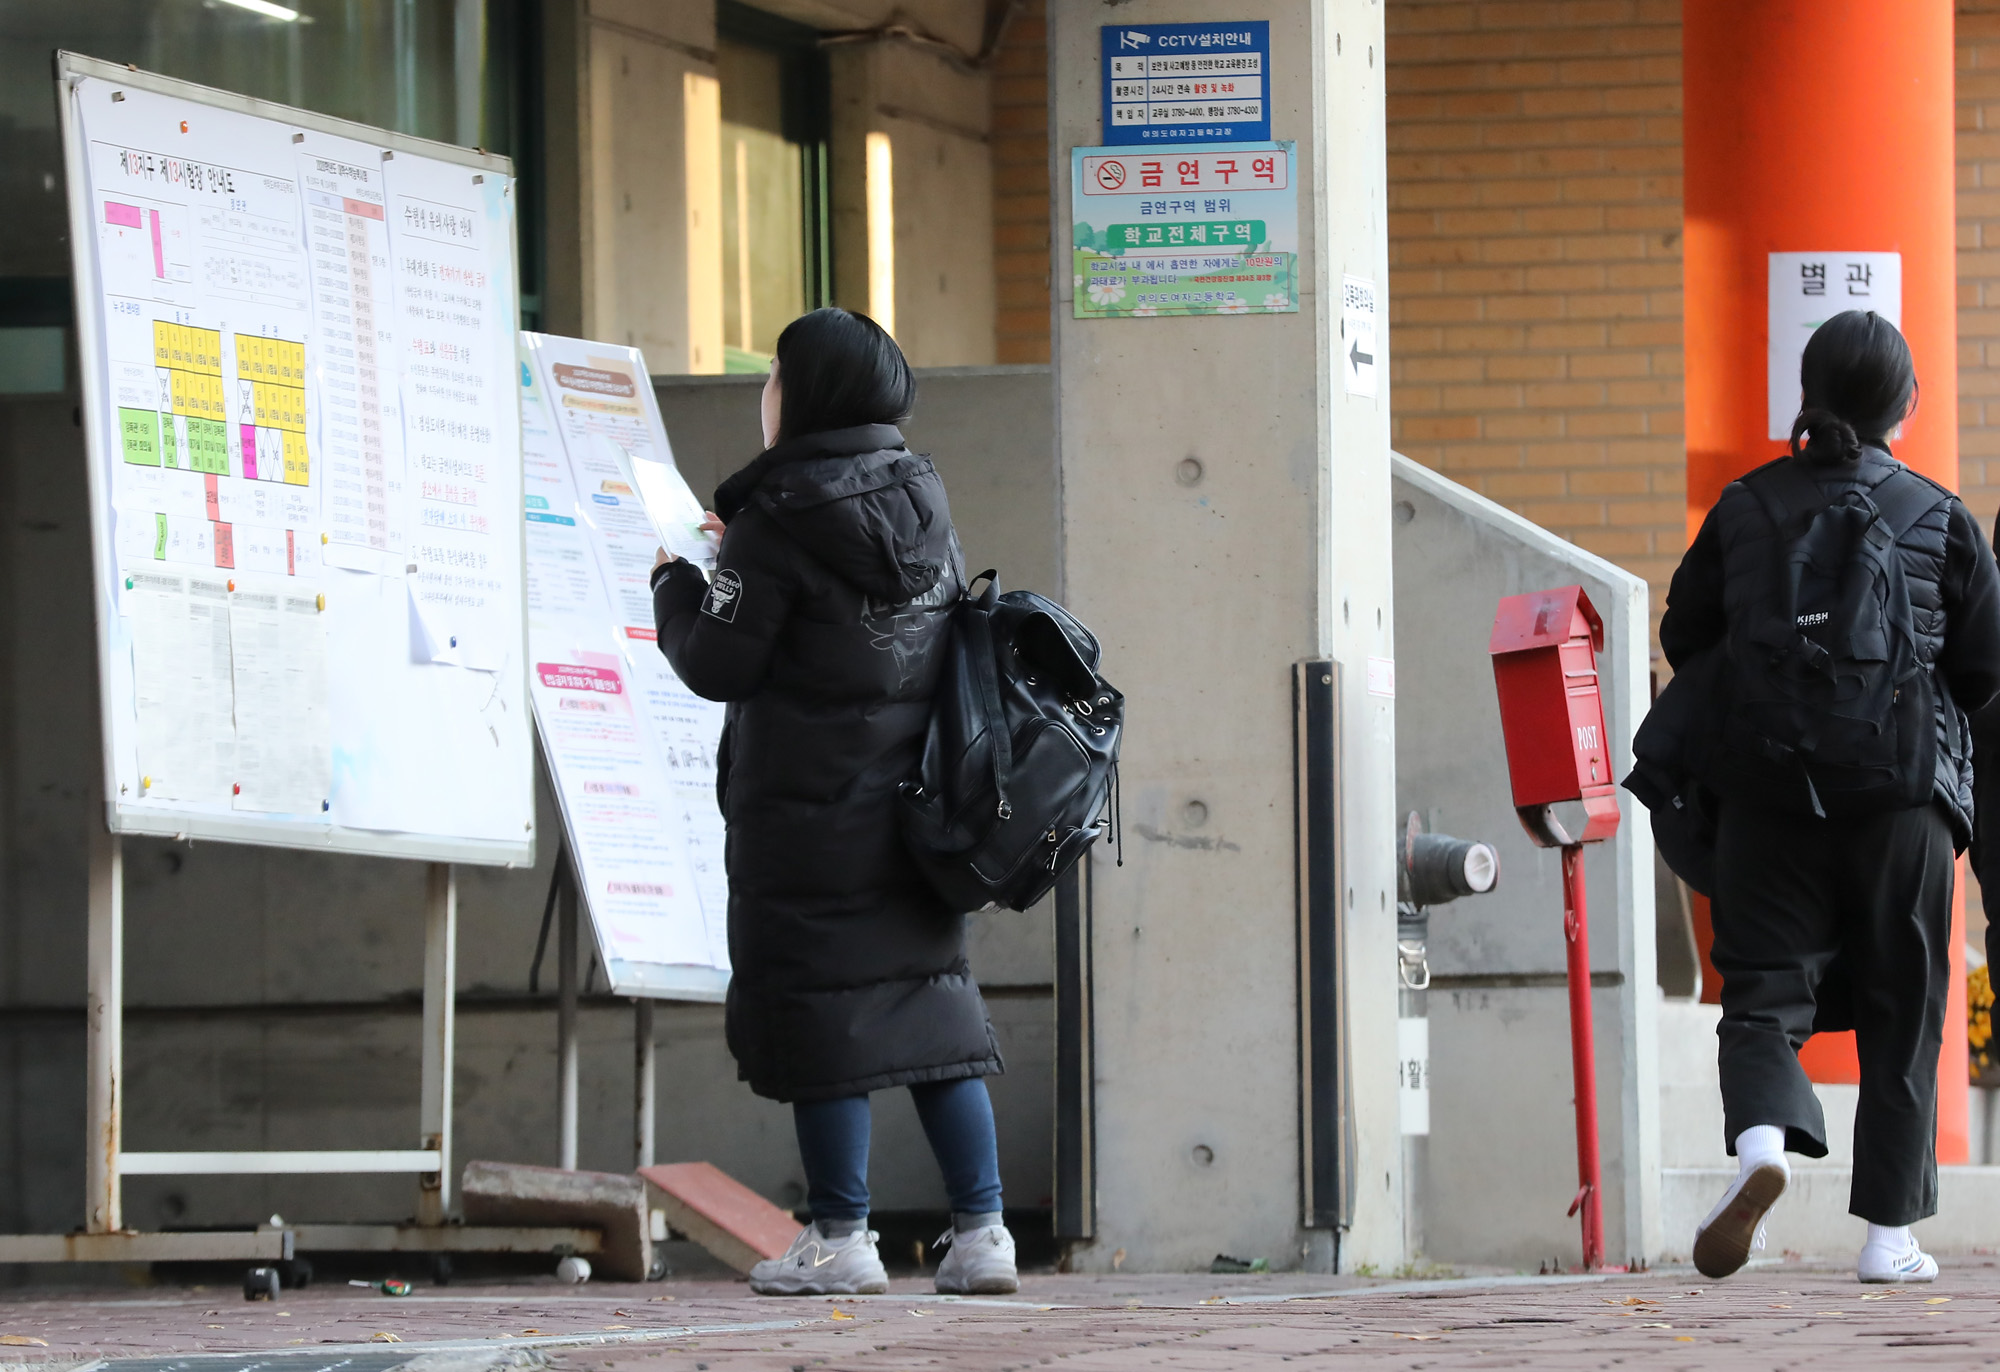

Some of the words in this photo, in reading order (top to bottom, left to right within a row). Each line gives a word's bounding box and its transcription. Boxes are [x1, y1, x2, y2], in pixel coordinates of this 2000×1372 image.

[1116, 86, 1144, 96] 촬영시간
[1152, 84, 1174, 95] 24시간
[1177, 84, 1190, 94] 연속
[1194, 83, 1207, 94] 촬영
[1211, 84, 1217, 93] 및
[1221, 82, 1234, 92] 녹화
[1152, 108, 1168, 118] 교무실
[1208, 106, 1224, 116] 행정실
[1227, 105, 1258, 115] 3780-4300
[1142, 128, 1232, 138] 여의도여자고등학교장
[120, 150, 155, 181] 제13지구
[160, 158, 202, 191] 제13시험장
[207, 168, 235, 194] 안내도
[1140, 199, 1196, 215] 금연구역
[1204, 198, 1231, 213] 범위
[429, 212, 456, 236] 유의사항
[1124, 223, 1251, 245] 학교전체구역
[1090, 261, 1126, 271] 학교시설
[1132, 261, 1140, 270] 내
[1146, 260, 1164, 270] 에서
[1170, 260, 1197, 270] 흡연한
[1203, 258, 1240, 268] 자에게는
[1245, 256, 1282, 267] 10만원의
[1090, 276, 1126, 286] 과태료가
[1138, 292, 1235, 304] 여의도여자고등학교
[717, 574, 740, 588] CHICAGO
[716, 582, 734, 594] BULLS
[1797, 612, 1828, 623] KIRSH
[1577, 726, 1598, 750] POST
